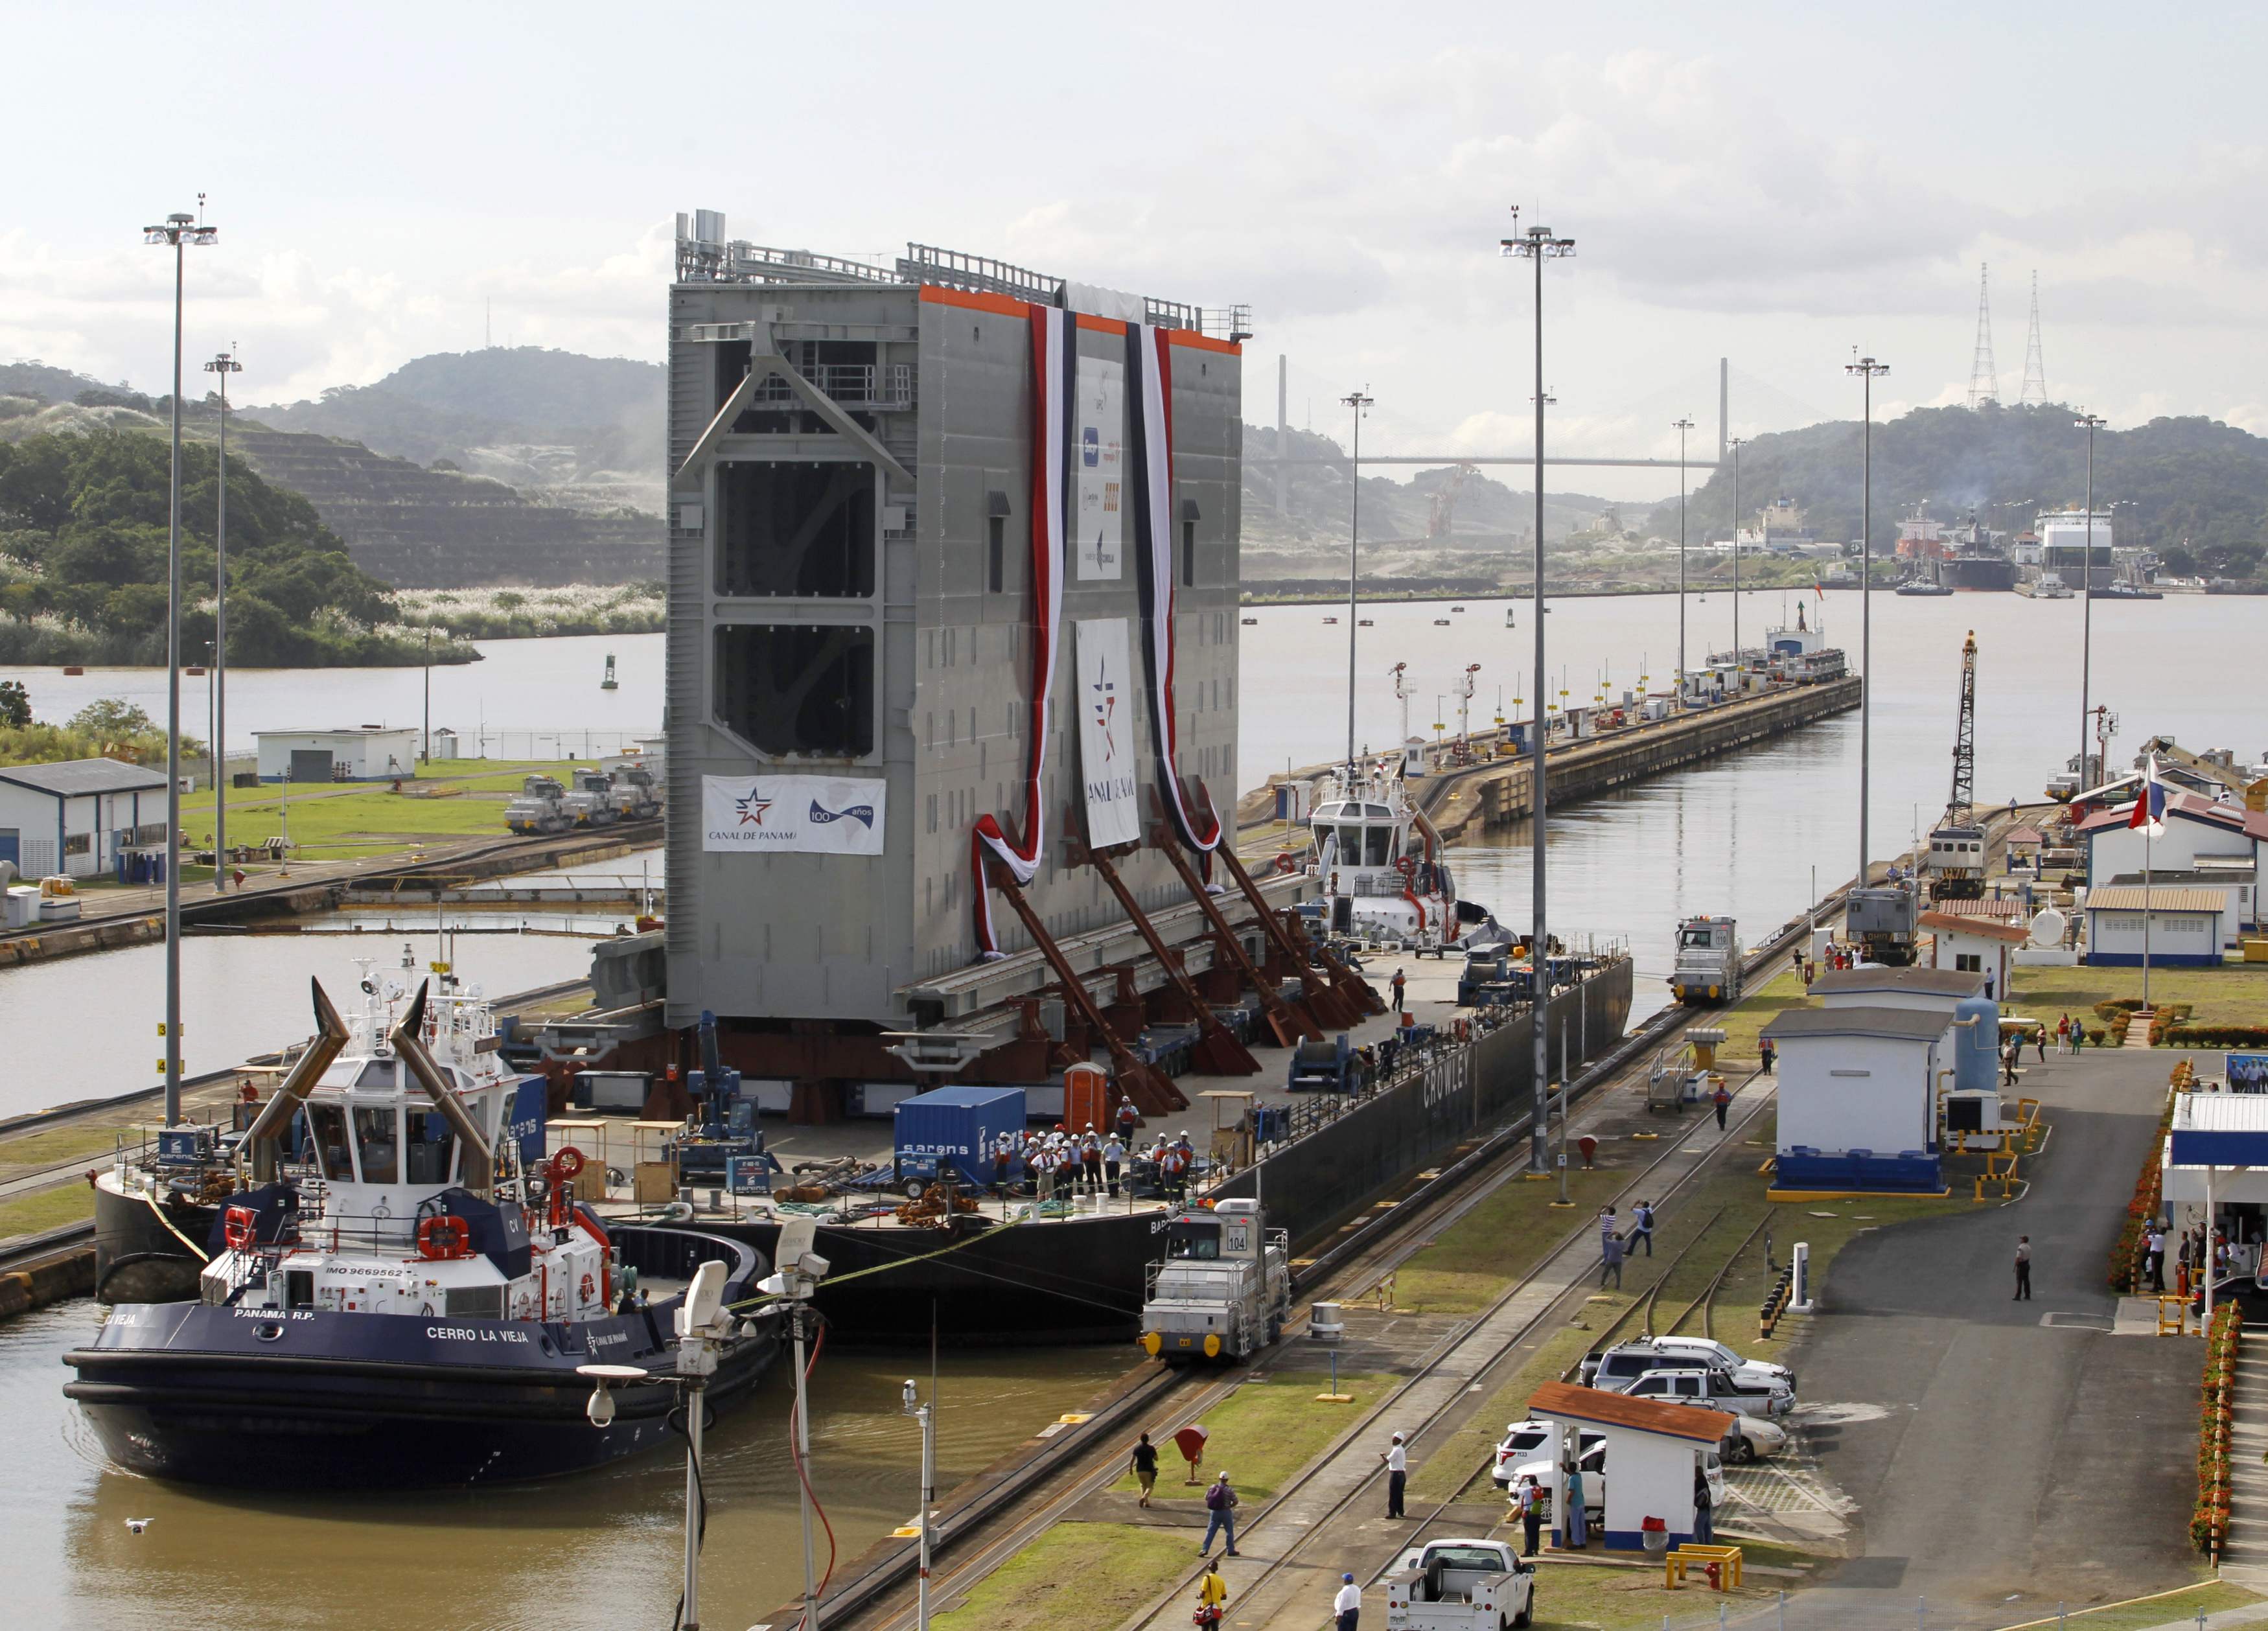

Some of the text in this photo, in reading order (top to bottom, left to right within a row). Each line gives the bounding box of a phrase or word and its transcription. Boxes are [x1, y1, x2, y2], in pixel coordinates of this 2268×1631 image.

[811, 811, 829, 822] 100
[851, 807, 872, 816] años
[709, 831, 739, 840] CANAL
[743, 831, 757, 840] DE
[1717, 935, 1726, 943] 110
[159, 1025, 166, 1035] 3
[159, 1061, 166, 1072] 4
[1424, 1050, 1469, 1109] CROWLEY
[903, 1144, 968, 1155] sarens
[509, 1218, 518, 1233] CV
[1229, 1238, 1245, 1249] 104
[349, 1268, 402, 1277] 9669562
[234, 1309, 315, 1320] PANAMA R.P.
[426, 1327, 529, 1343] CERRO LA VIEJA
